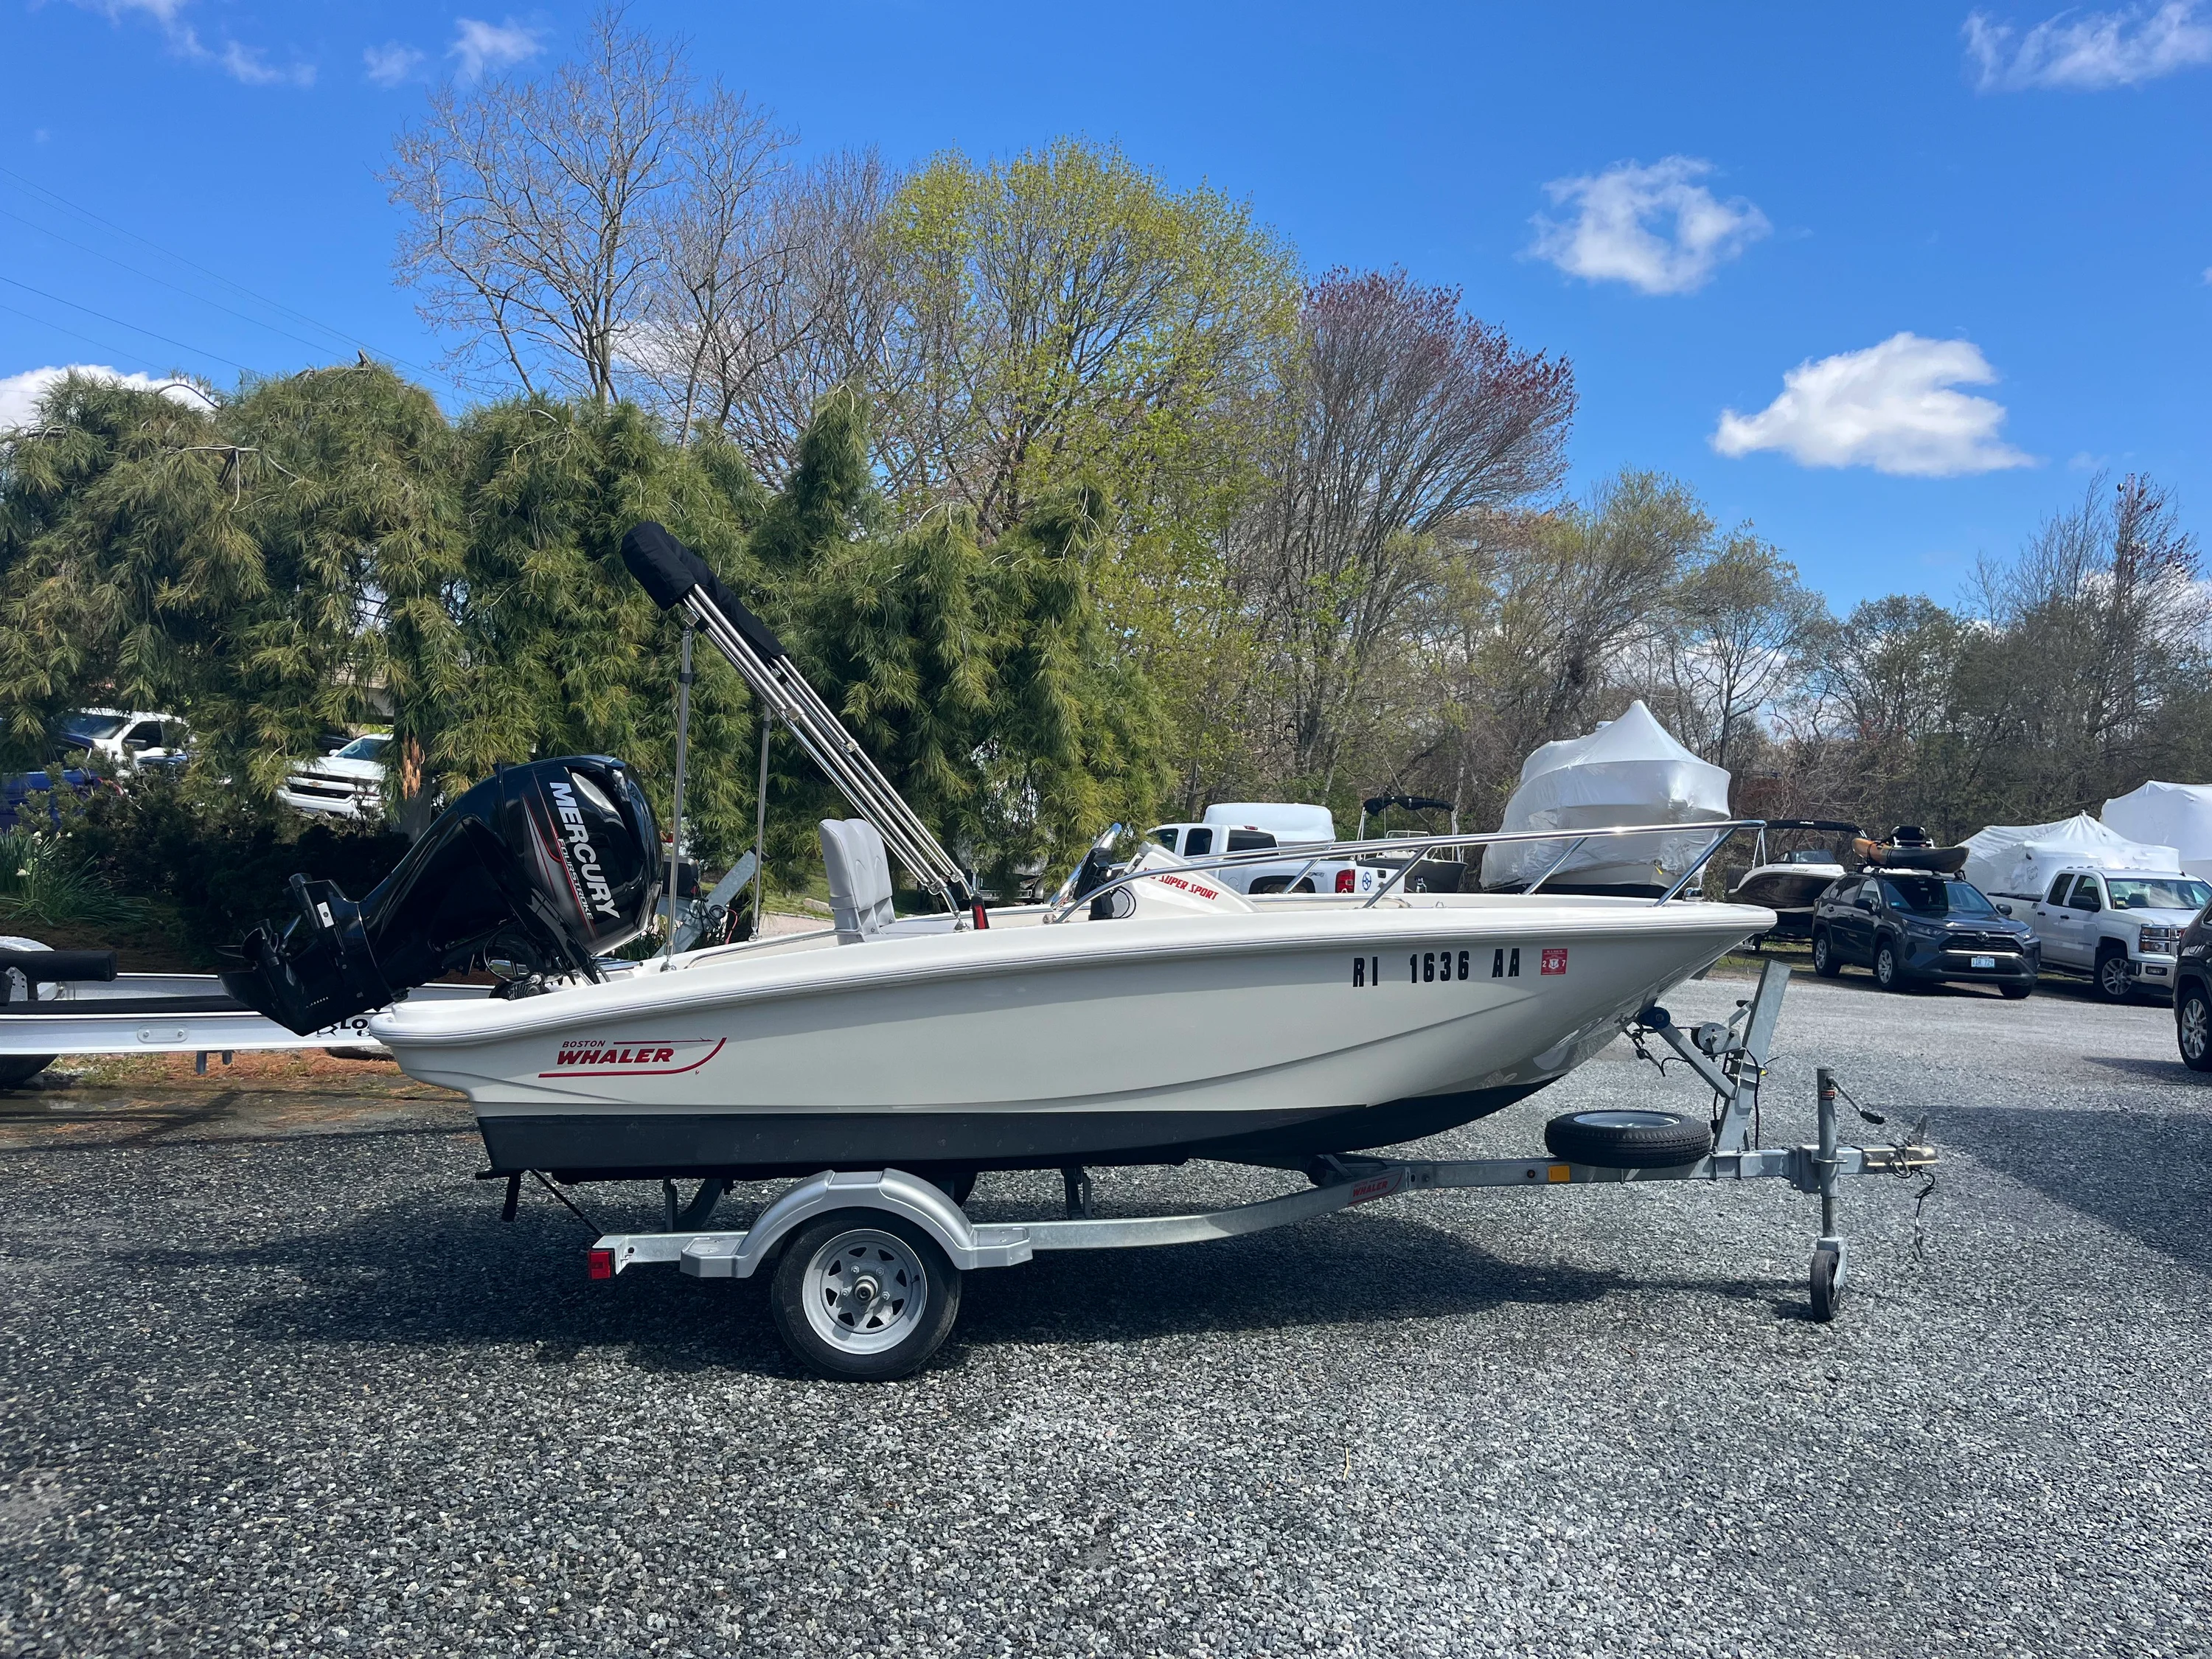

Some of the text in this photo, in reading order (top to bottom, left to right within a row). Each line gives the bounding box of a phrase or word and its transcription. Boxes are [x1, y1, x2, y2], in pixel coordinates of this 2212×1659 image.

[549, 782, 621, 919] MERCURY
[557, 838, 594, 921] FOURSTROKE
[1158, 874, 1219, 900] SUPER SPORT
[1352, 948, 1520, 987] RI 1636 AA
[340, 1018, 370, 1029] LO
[562, 1040, 606, 1048] BOSTON
[557, 1048, 675, 1065] WHALER
[1352, 1180, 1388, 1197] WHALER
